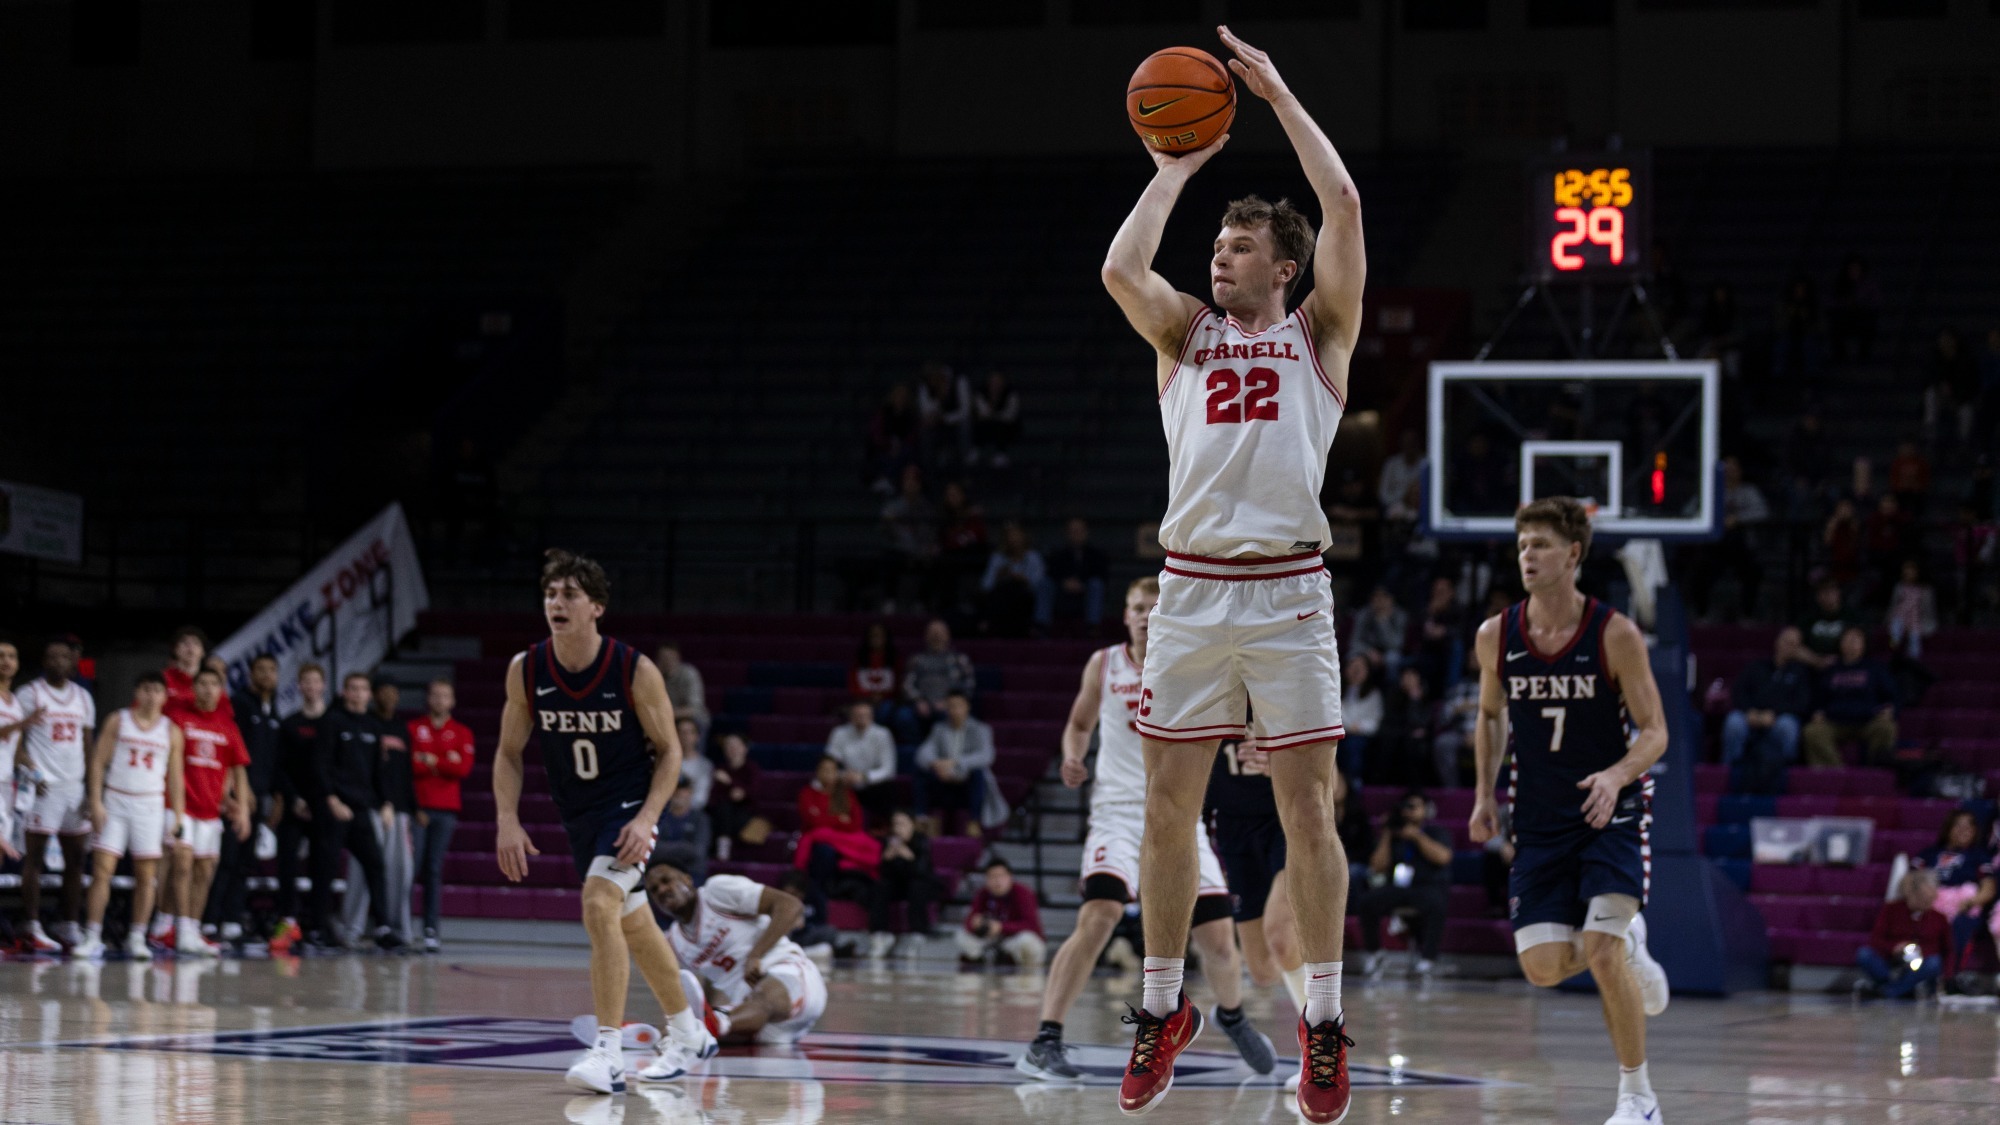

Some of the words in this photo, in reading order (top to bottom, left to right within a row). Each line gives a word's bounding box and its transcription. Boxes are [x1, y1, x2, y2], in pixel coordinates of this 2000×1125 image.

[1143, 130, 1198, 148] ELITE
[1554, 168, 1633, 207] 12:55
[1551, 206, 1624, 270] 29
[1206, 367, 1279, 425] 22
[322, 539, 388, 613] ZONE
[1140, 688, 1153, 717] C
[1507, 674, 1597, 700] PENN
[538, 709, 623, 733] PENN
[1540, 706, 1566, 752] 7
[572, 738, 599, 780] 0
[712, 956, 736, 973] 5
